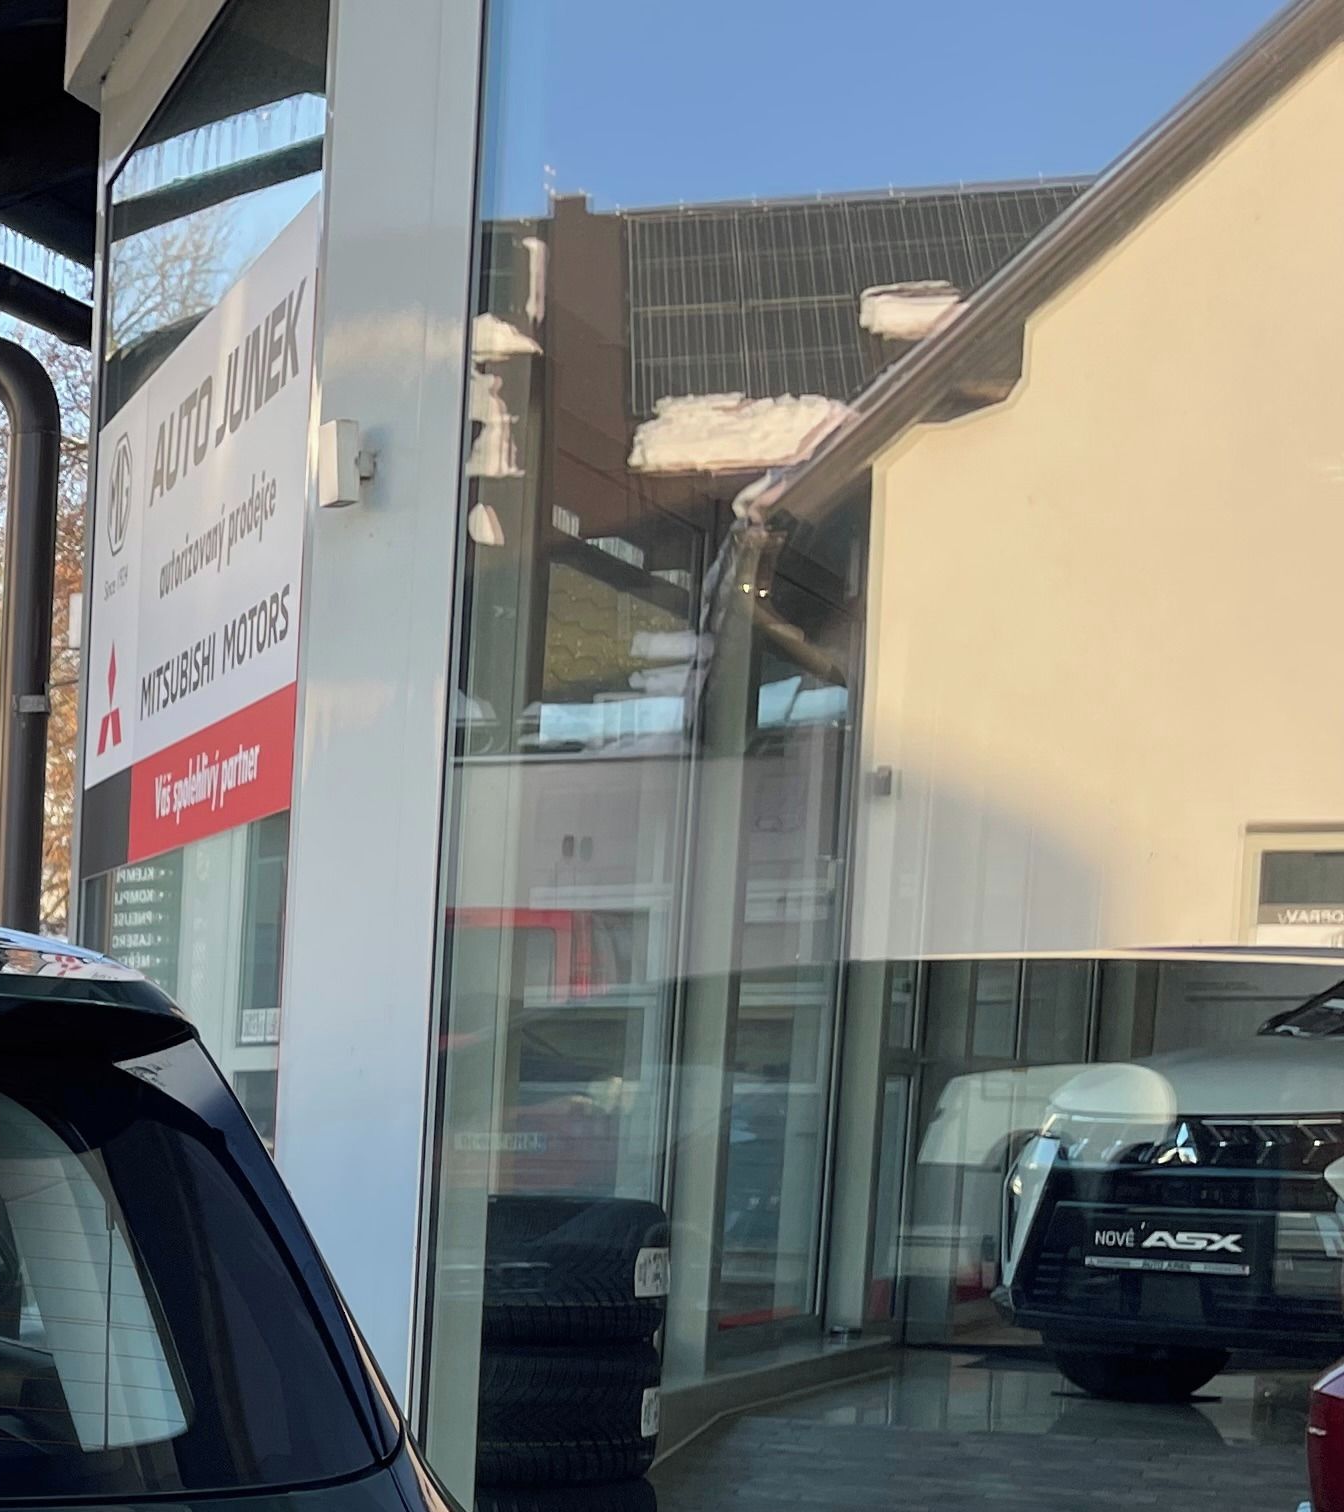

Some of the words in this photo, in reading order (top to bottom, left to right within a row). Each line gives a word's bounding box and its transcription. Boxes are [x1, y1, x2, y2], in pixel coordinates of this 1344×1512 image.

[150, 375, 213, 507] AUTO
[215, 276, 307, 448] JUNEK
[110, 440, 131, 550] MG
[159, 504, 225, 599] autorizovaný
[226, 470, 277, 566] prodejce
[140, 632, 216, 721] MITSUBISHI
[222, 583, 290, 674] MOTORS
[154, 772, 172, 819] Váš
[172, 750, 220, 825] spolehlivý
[220, 744, 261, 808] partner
[1094, 1228, 1135, 1248] NOVÉ
[1141, 1230, 1243, 1252] ASX
